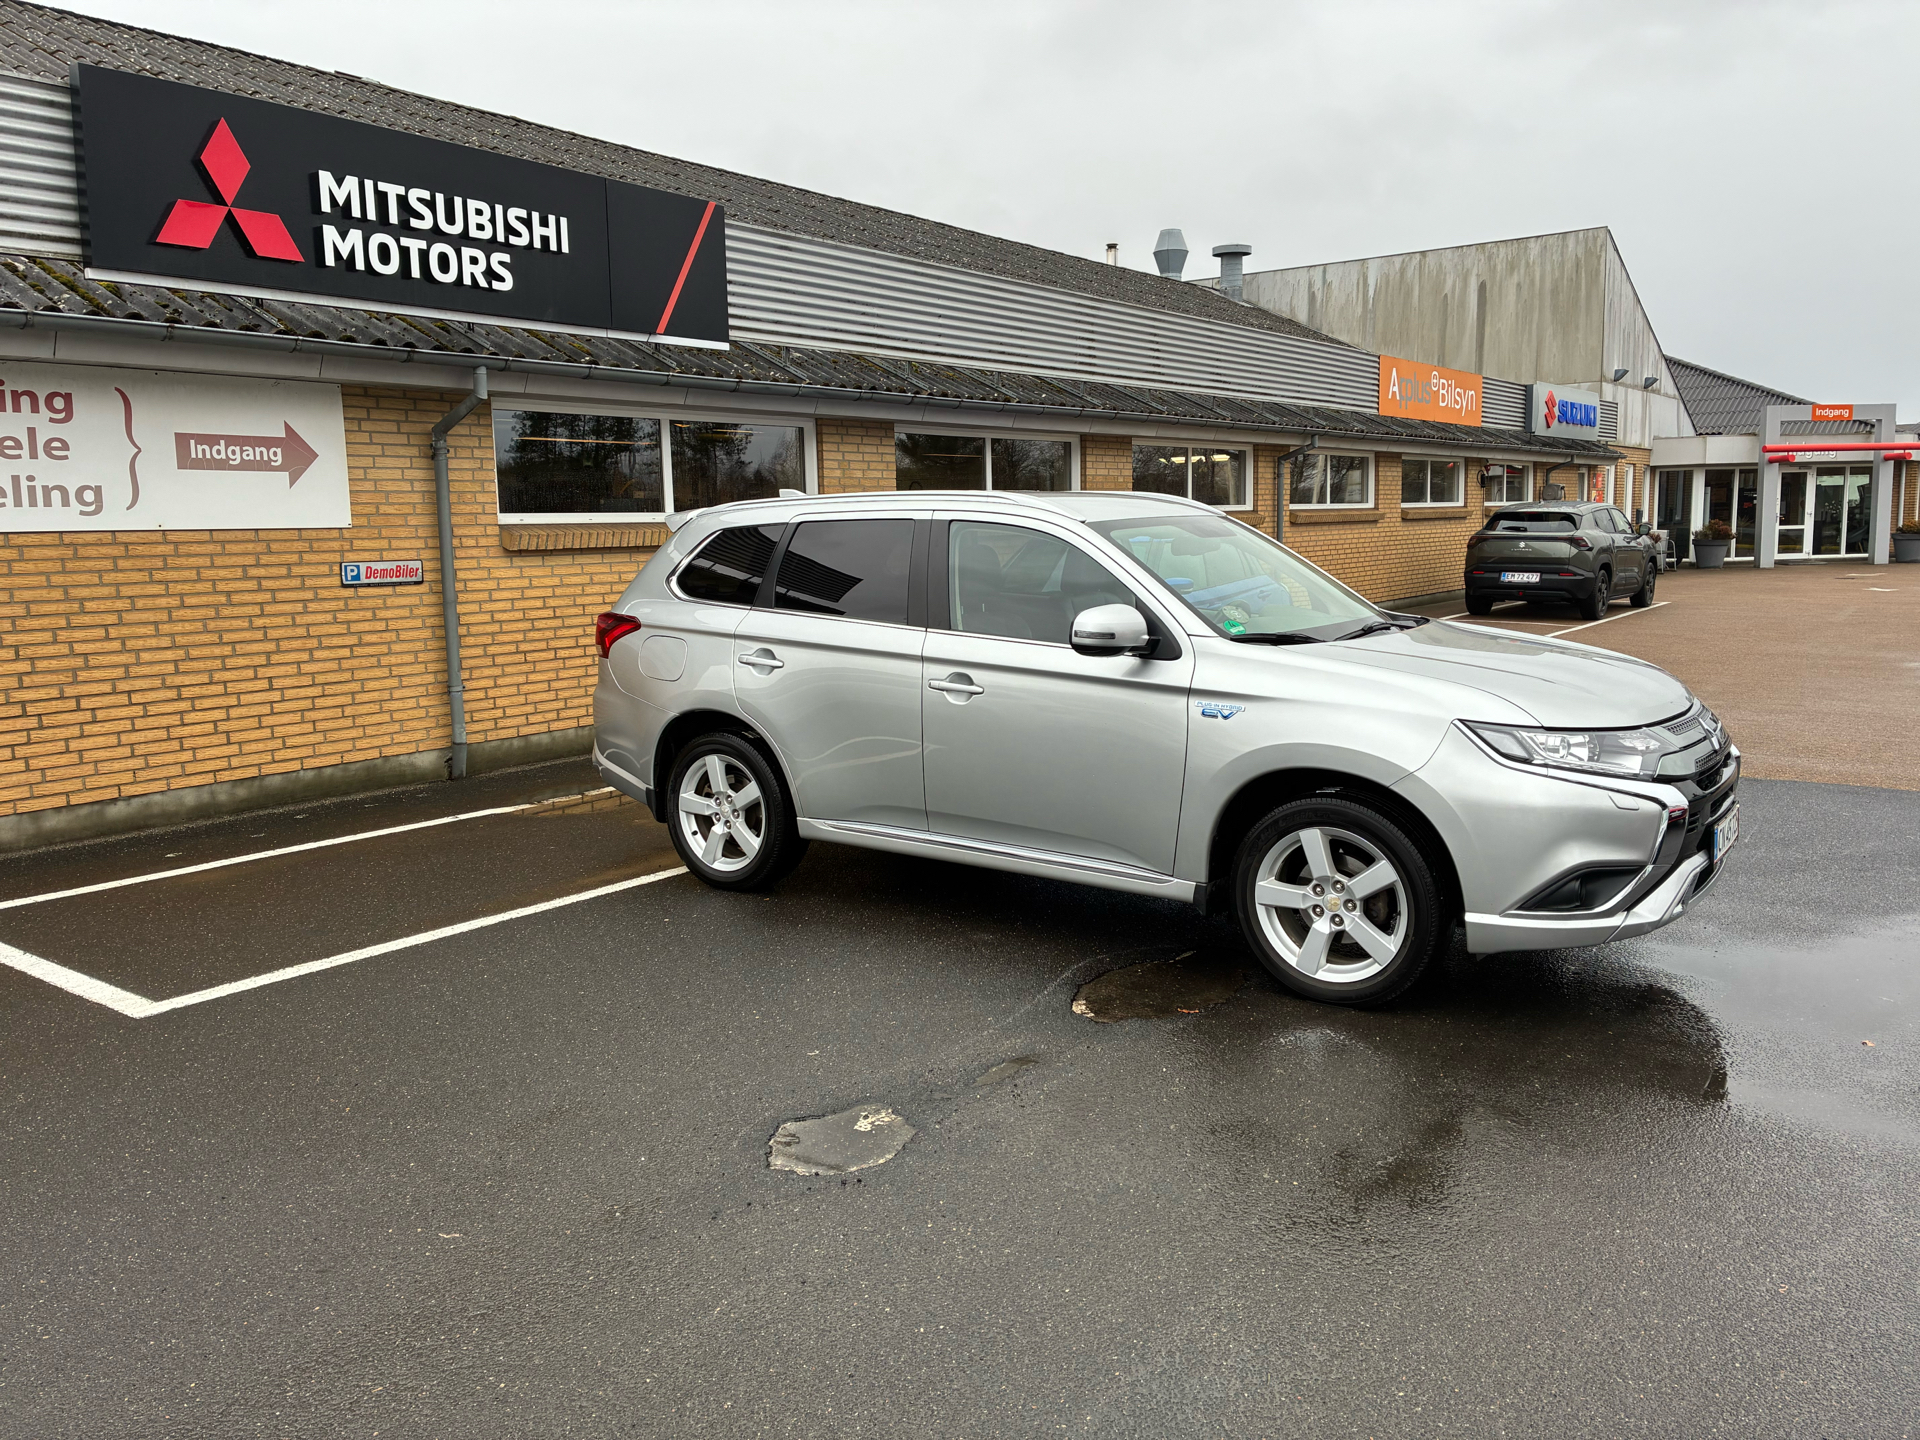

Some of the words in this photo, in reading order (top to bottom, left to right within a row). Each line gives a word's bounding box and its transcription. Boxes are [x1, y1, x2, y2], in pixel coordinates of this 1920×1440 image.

[318, 169, 569, 254] MITSUBISHI
[322, 224, 514, 292] MOTORS
[1439, 378, 1476, 417] Bilsyn
[1815, 407, 1849, 418] Indgang
[1557, 398, 1598, 428] SUZUKI
[189, 439, 283, 466] Indgang
[0, 474, 104, 517] ling
[346, 565, 358, 580] P
[364, 564, 420, 580] DemoBiler
[1201, 708, 1239, 720] EV
